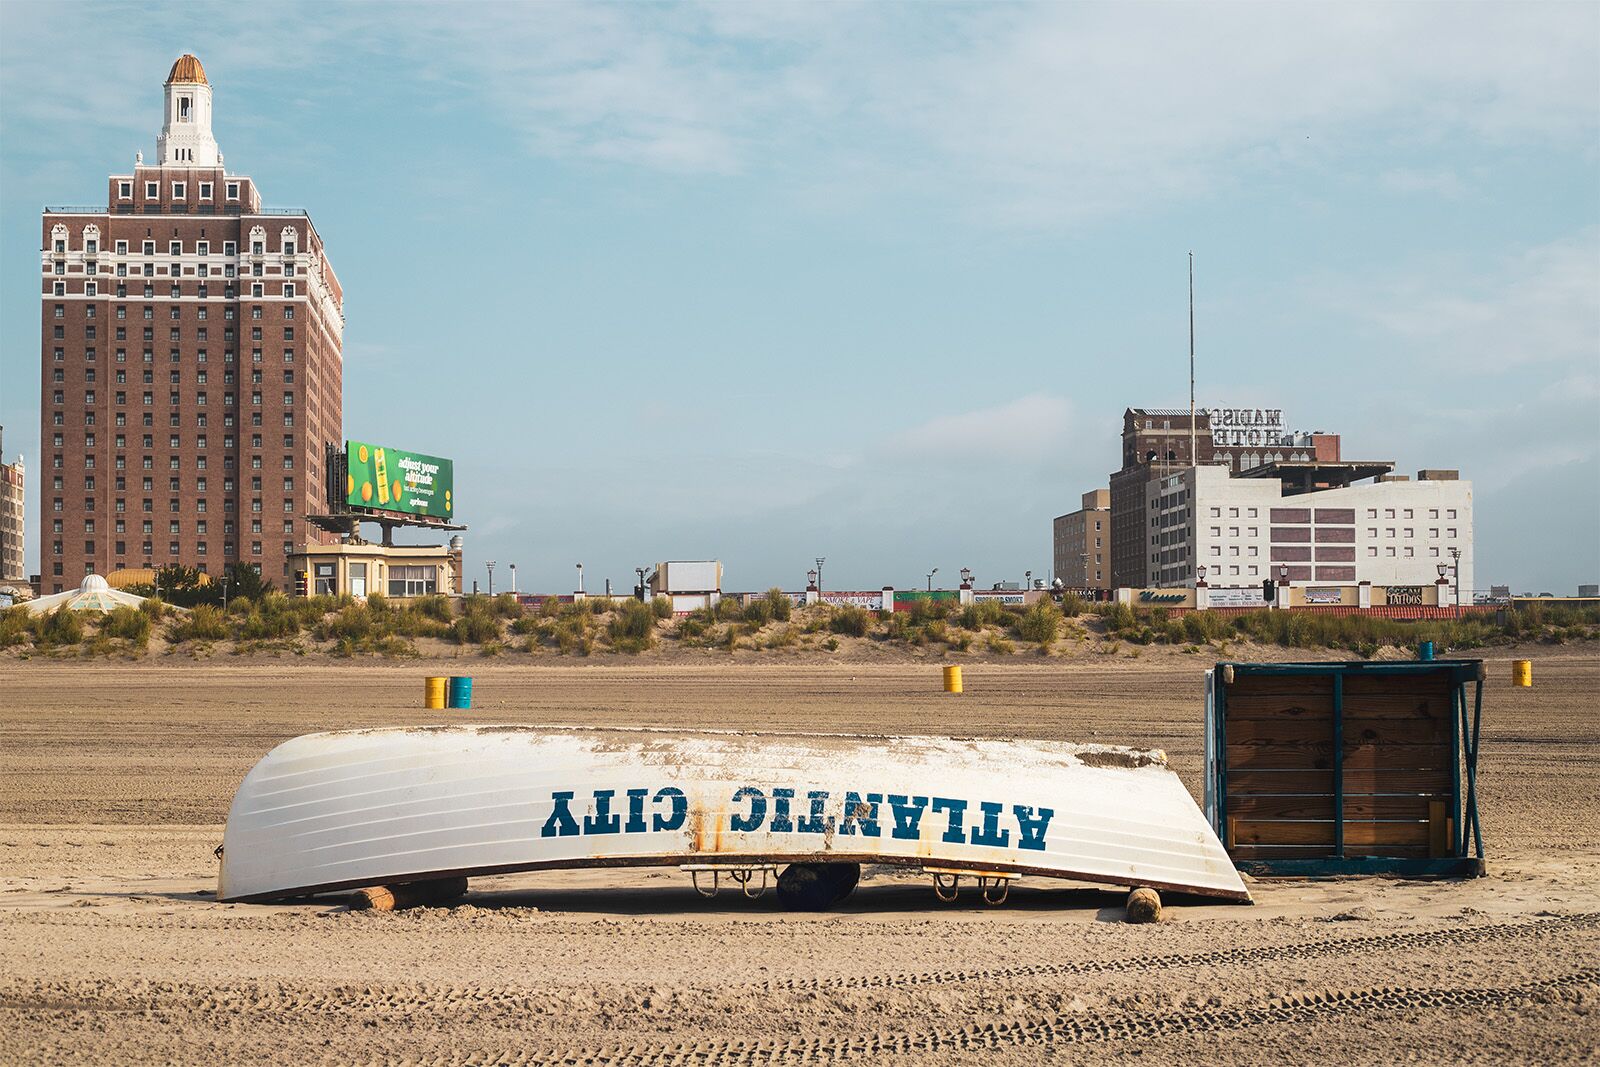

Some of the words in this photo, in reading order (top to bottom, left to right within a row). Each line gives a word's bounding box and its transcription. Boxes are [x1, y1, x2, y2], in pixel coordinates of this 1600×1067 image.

[398, 457, 421, 471] adjust
[421, 463, 439, 474] your
[404, 470, 433, 485] altitude
[1386, 593, 1422, 605] TATTOOS
[541, 786, 688, 837] CITY
[730, 786, 1055, 851] ATLANTIC
